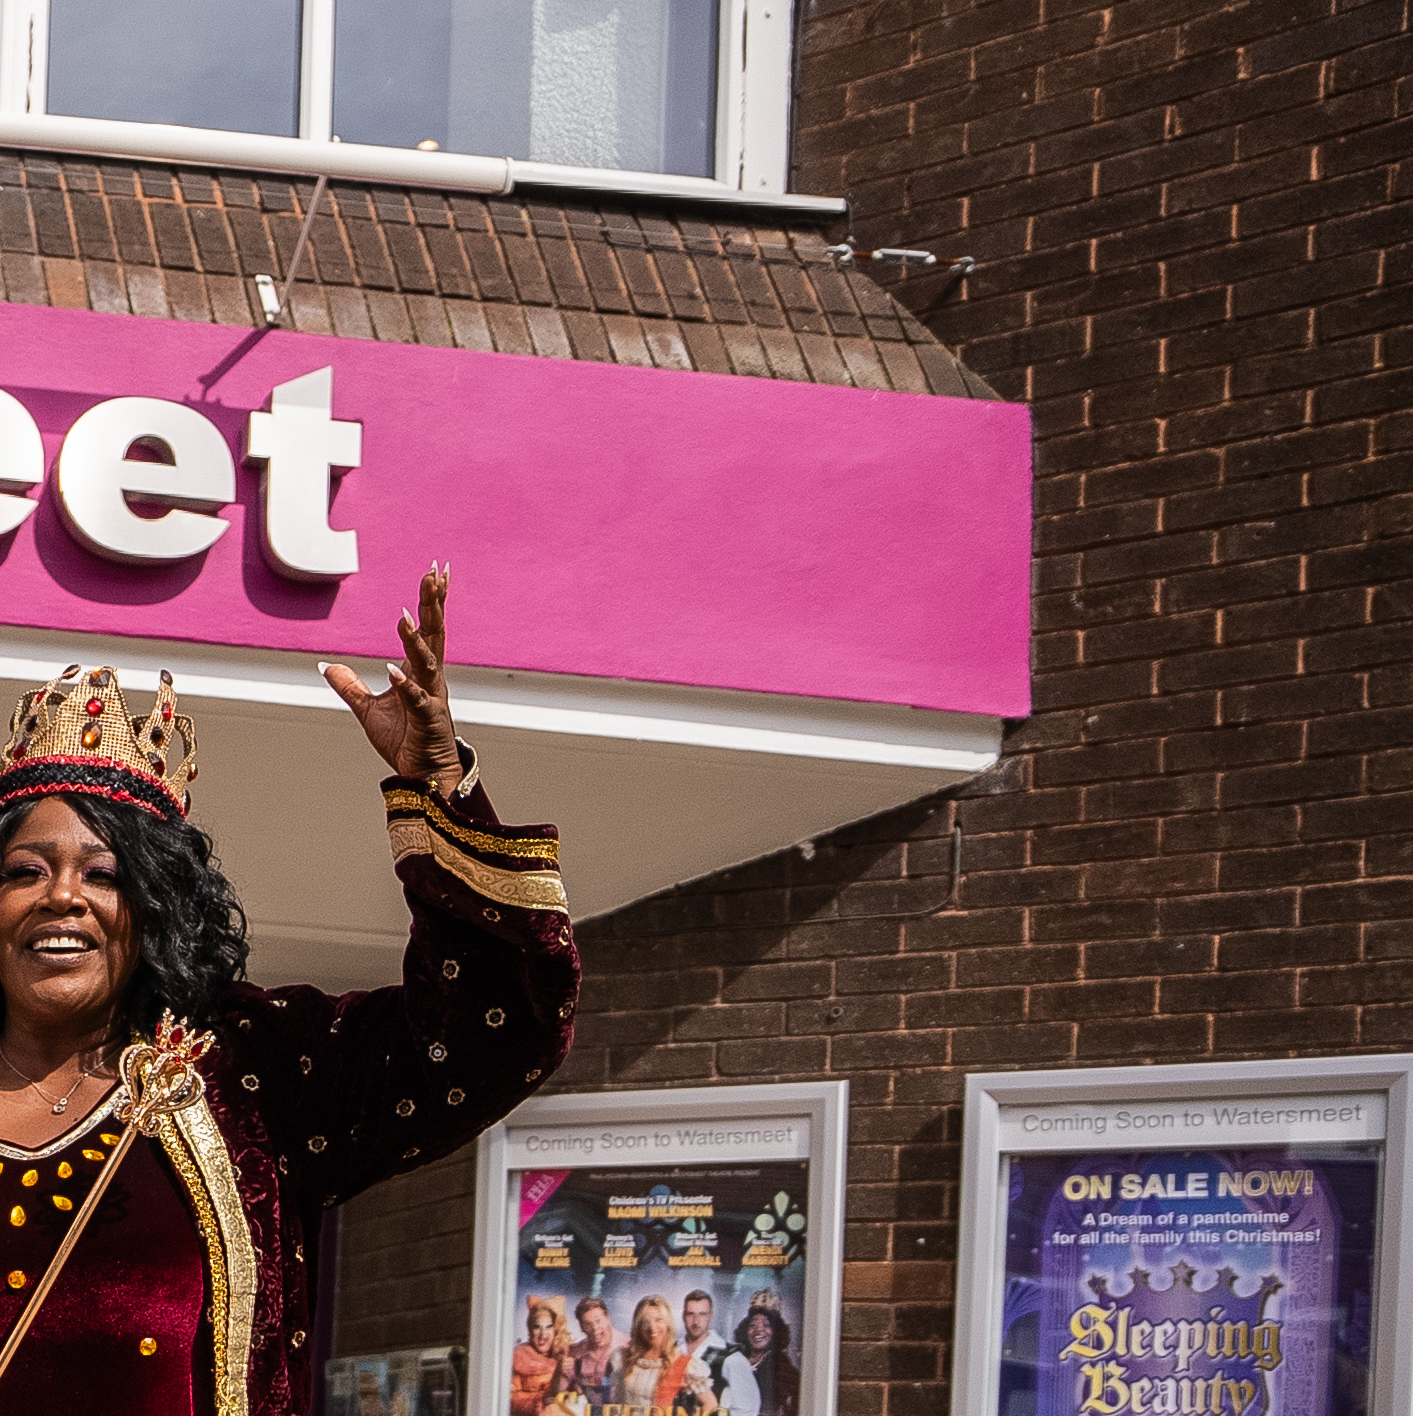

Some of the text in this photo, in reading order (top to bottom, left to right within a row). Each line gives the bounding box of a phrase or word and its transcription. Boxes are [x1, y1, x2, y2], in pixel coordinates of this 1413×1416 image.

[1023, 1103, 1363, 1134] Coming Soon to Watersmeet
[526, 1126, 793, 1153] Coming Soon to Watersmeet
[1063, 1169, 1314, 1201] ON SALE NOW!
[1082, 1211, 1290, 1228] A Dream of a pantomime
[1052, 1228, 1322, 1248] for all the family this Christmas!
[1058, 1301, 1283, 1372] Sleeping
